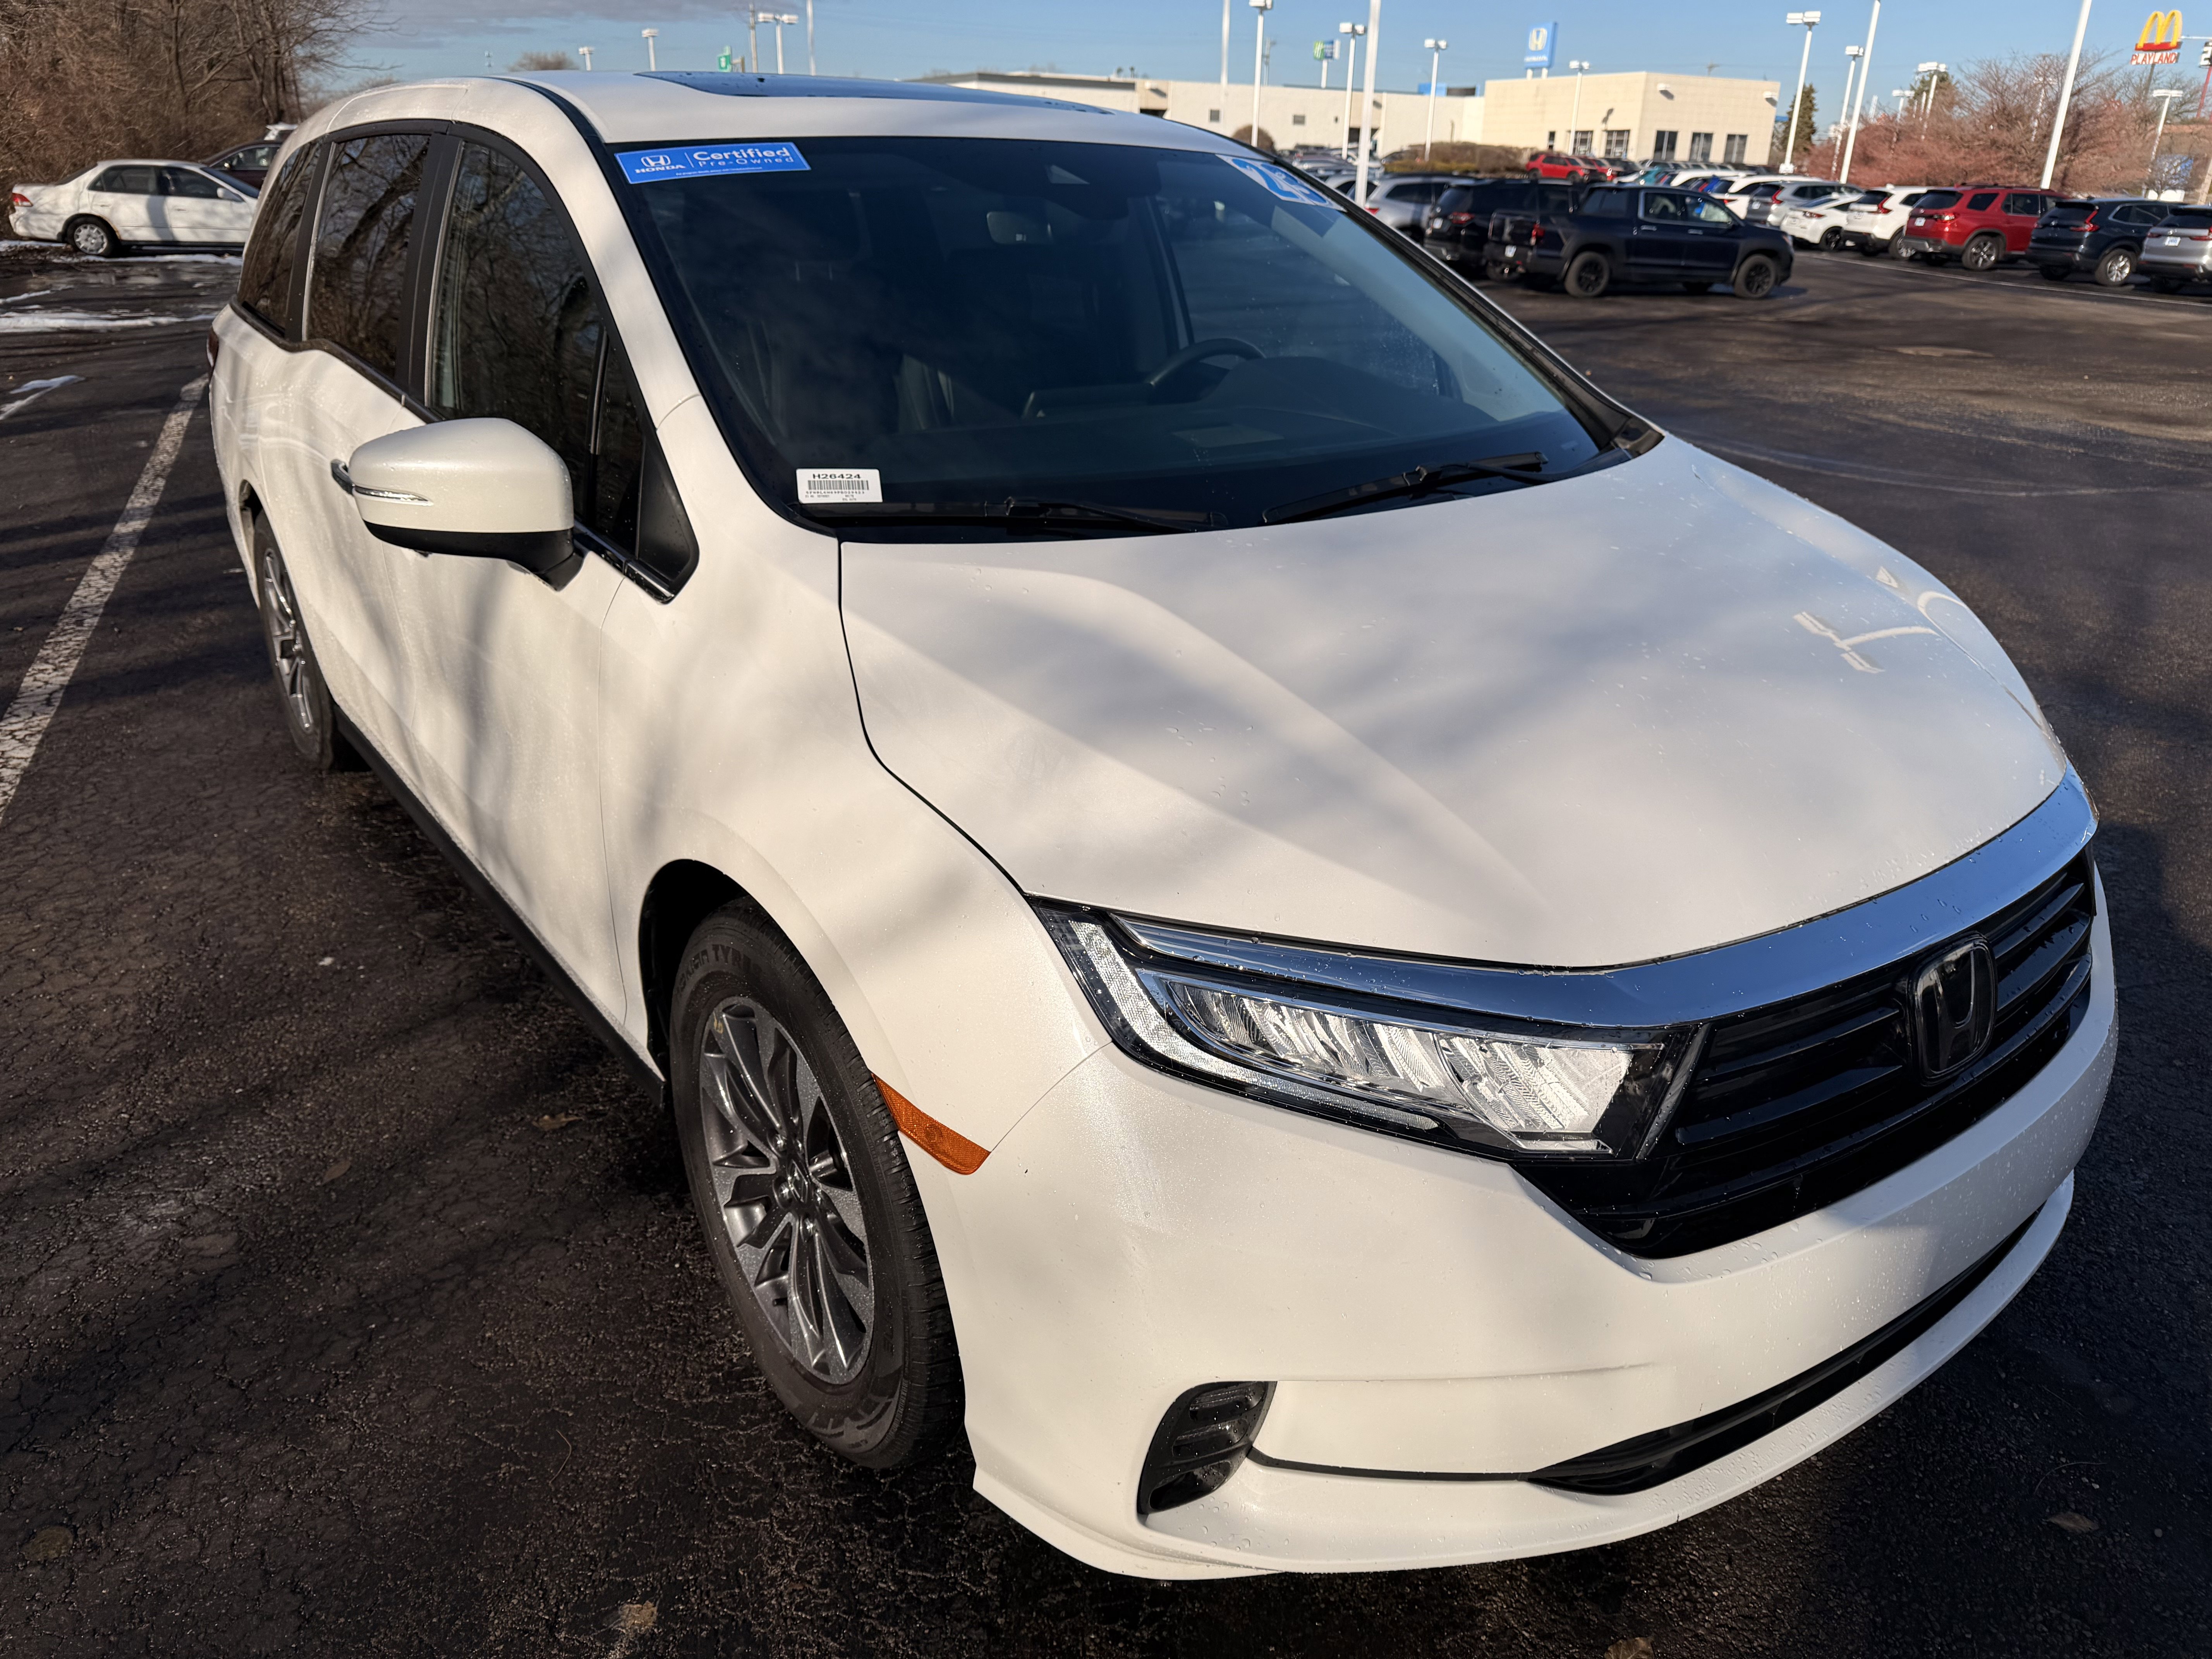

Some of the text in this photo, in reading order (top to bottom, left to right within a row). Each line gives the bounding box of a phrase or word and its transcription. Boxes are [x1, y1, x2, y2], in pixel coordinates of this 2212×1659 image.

[2131, 53, 2178, 65] PLAYLAND
[693, 147, 790, 161] Certified
[698, 156, 794, 167] Pre-Owned
[634, 164, 686, 173] HONDA
